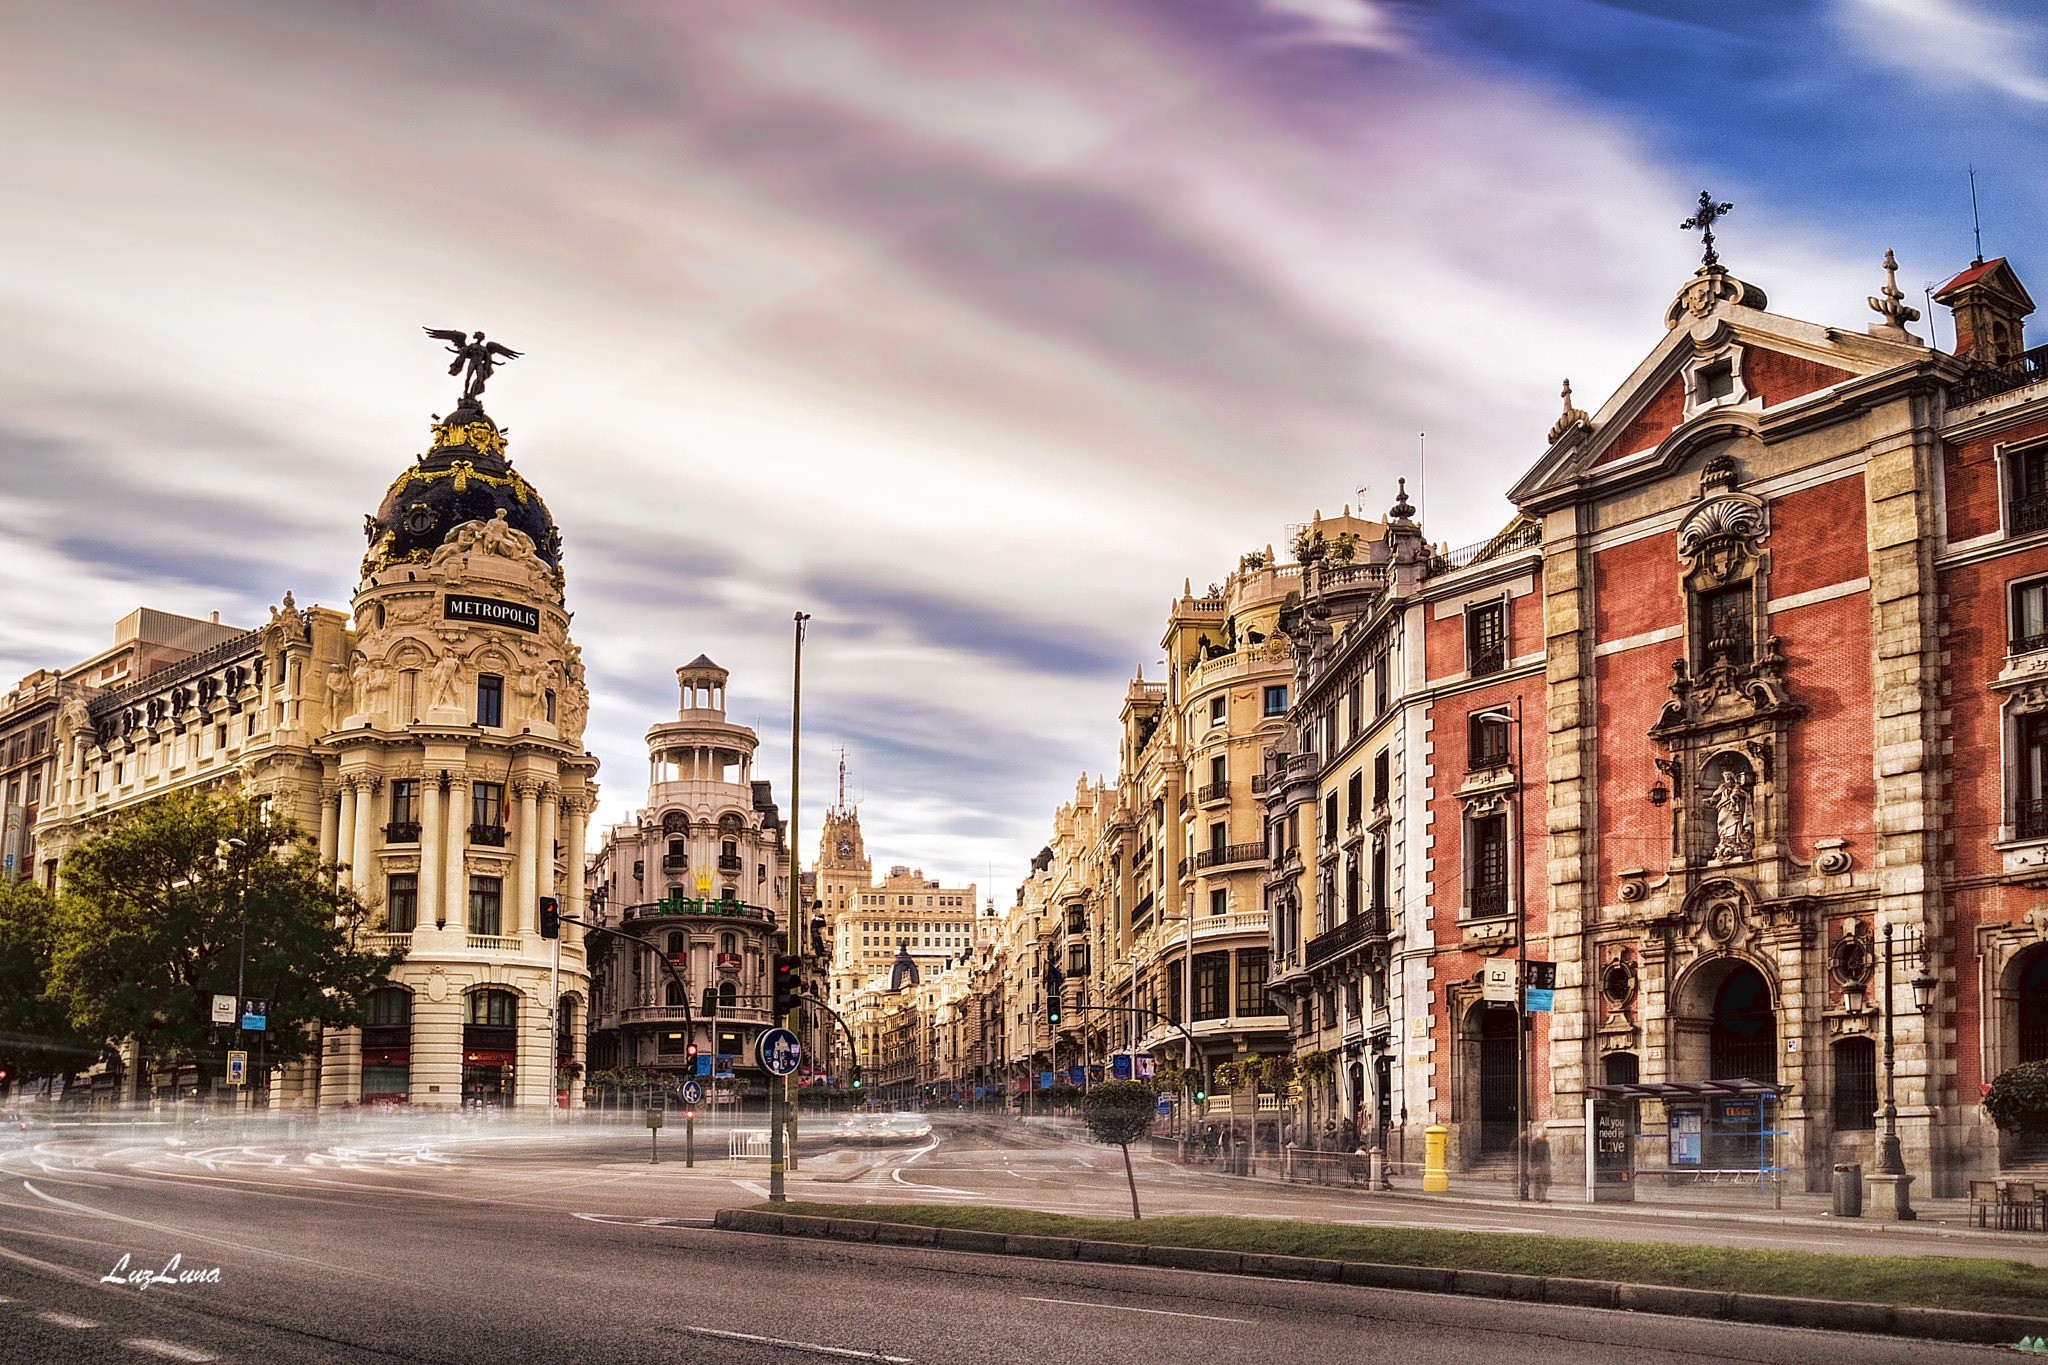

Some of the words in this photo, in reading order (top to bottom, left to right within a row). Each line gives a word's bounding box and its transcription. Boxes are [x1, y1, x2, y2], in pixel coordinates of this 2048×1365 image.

[451, 600, 536, 626] METROPOLIS
[657, 897, 747, 916] ROLEX
[1599, 1116, 1610, 1127] All
[1611, 1118, 1625, 1128] you
[1599, 1128, 1617, 1138] need
[1618, 1128, 1625, 1138] is
